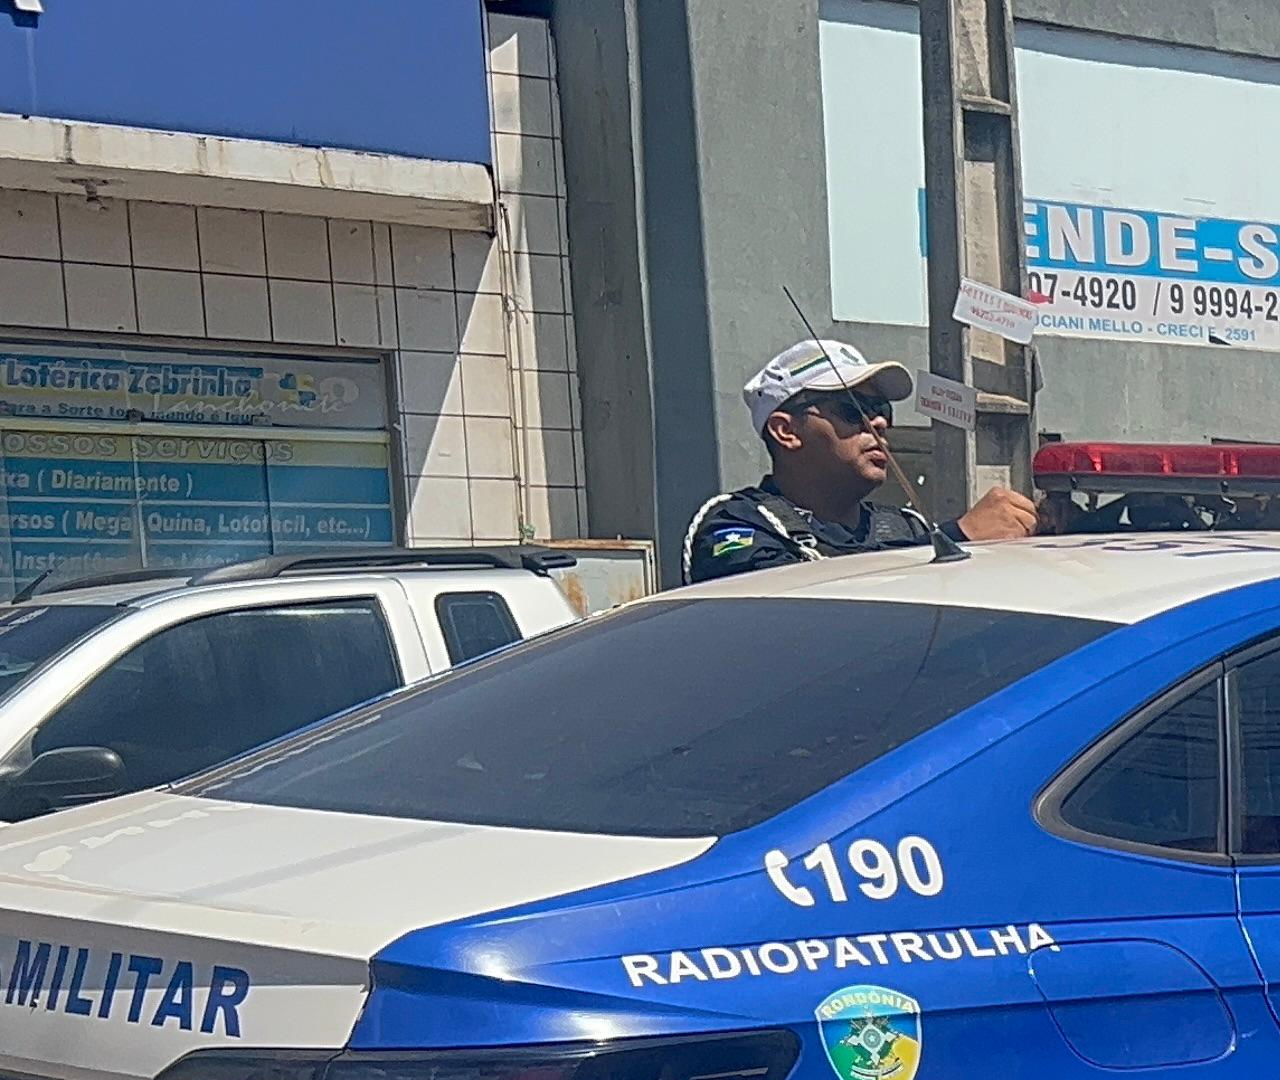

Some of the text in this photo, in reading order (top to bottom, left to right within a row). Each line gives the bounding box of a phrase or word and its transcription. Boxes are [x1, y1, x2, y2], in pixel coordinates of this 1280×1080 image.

[1028, 271, 1137, 311] 07-4920
[1170, 283, 1185, 315] 9
[1089, 317, 1143, 335] MELLO
[1157, 322, 1203, 338] CRECI
[1225, 327, 1256, 342] 2591
[5, 357, 252, 398] Lotérica Zebrinha
[58, 402, 104, 417] Sorte
[2, 432, 295, 465] ossos Serviços
[51, 469, 181, 493] Diariamente
[75, 511, 132, 536] Mega
[147, 512, 212, 537] Quina,
[803, 835, 945, 903] 190
[621, 922, 1061, 987] RADIOPATRULHA
[5, 939, 250, 1038] MILITAR
